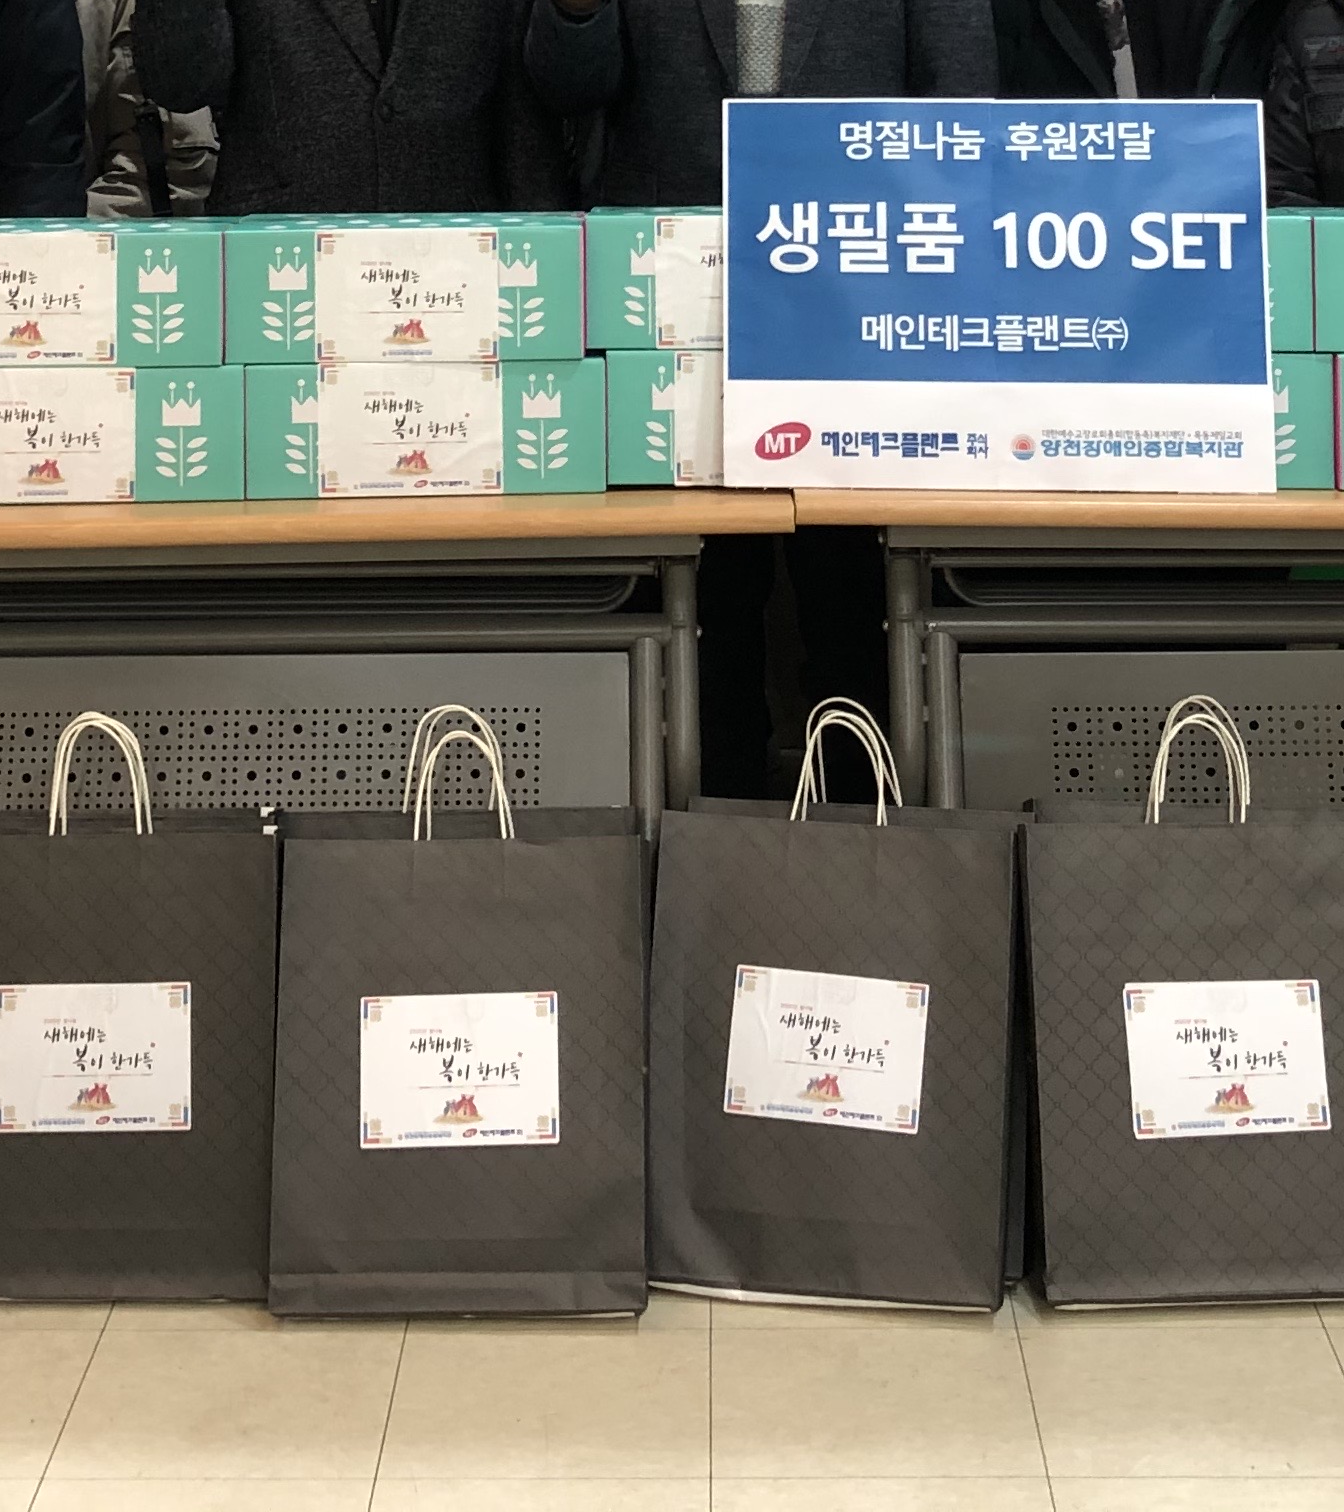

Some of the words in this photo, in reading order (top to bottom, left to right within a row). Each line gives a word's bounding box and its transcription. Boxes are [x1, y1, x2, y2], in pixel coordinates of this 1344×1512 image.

[839, 120, 986, 161] 명절나눔
[1004, 121, 1156, 162] 후원전달
[755, 201, 965, 274] 생필품
[992, 211, 1108, 270] 100
[1130, 211, 1247, 270] SET
[360, 268, 420, 284] 새해에는
[363, 398, 424, 415] 새해에는
[763, 431, 802, 455] MT
[1040, 439, 1244, 459] 양천장애인종합복지관
[779, 1012, 841, 1033] 새해에는
[43, 1026, 107, 1044] 새해에는
[1176, 1026, 1238, 1045] 새해에는
[409, 1036, 473, 1054] 새해에는
